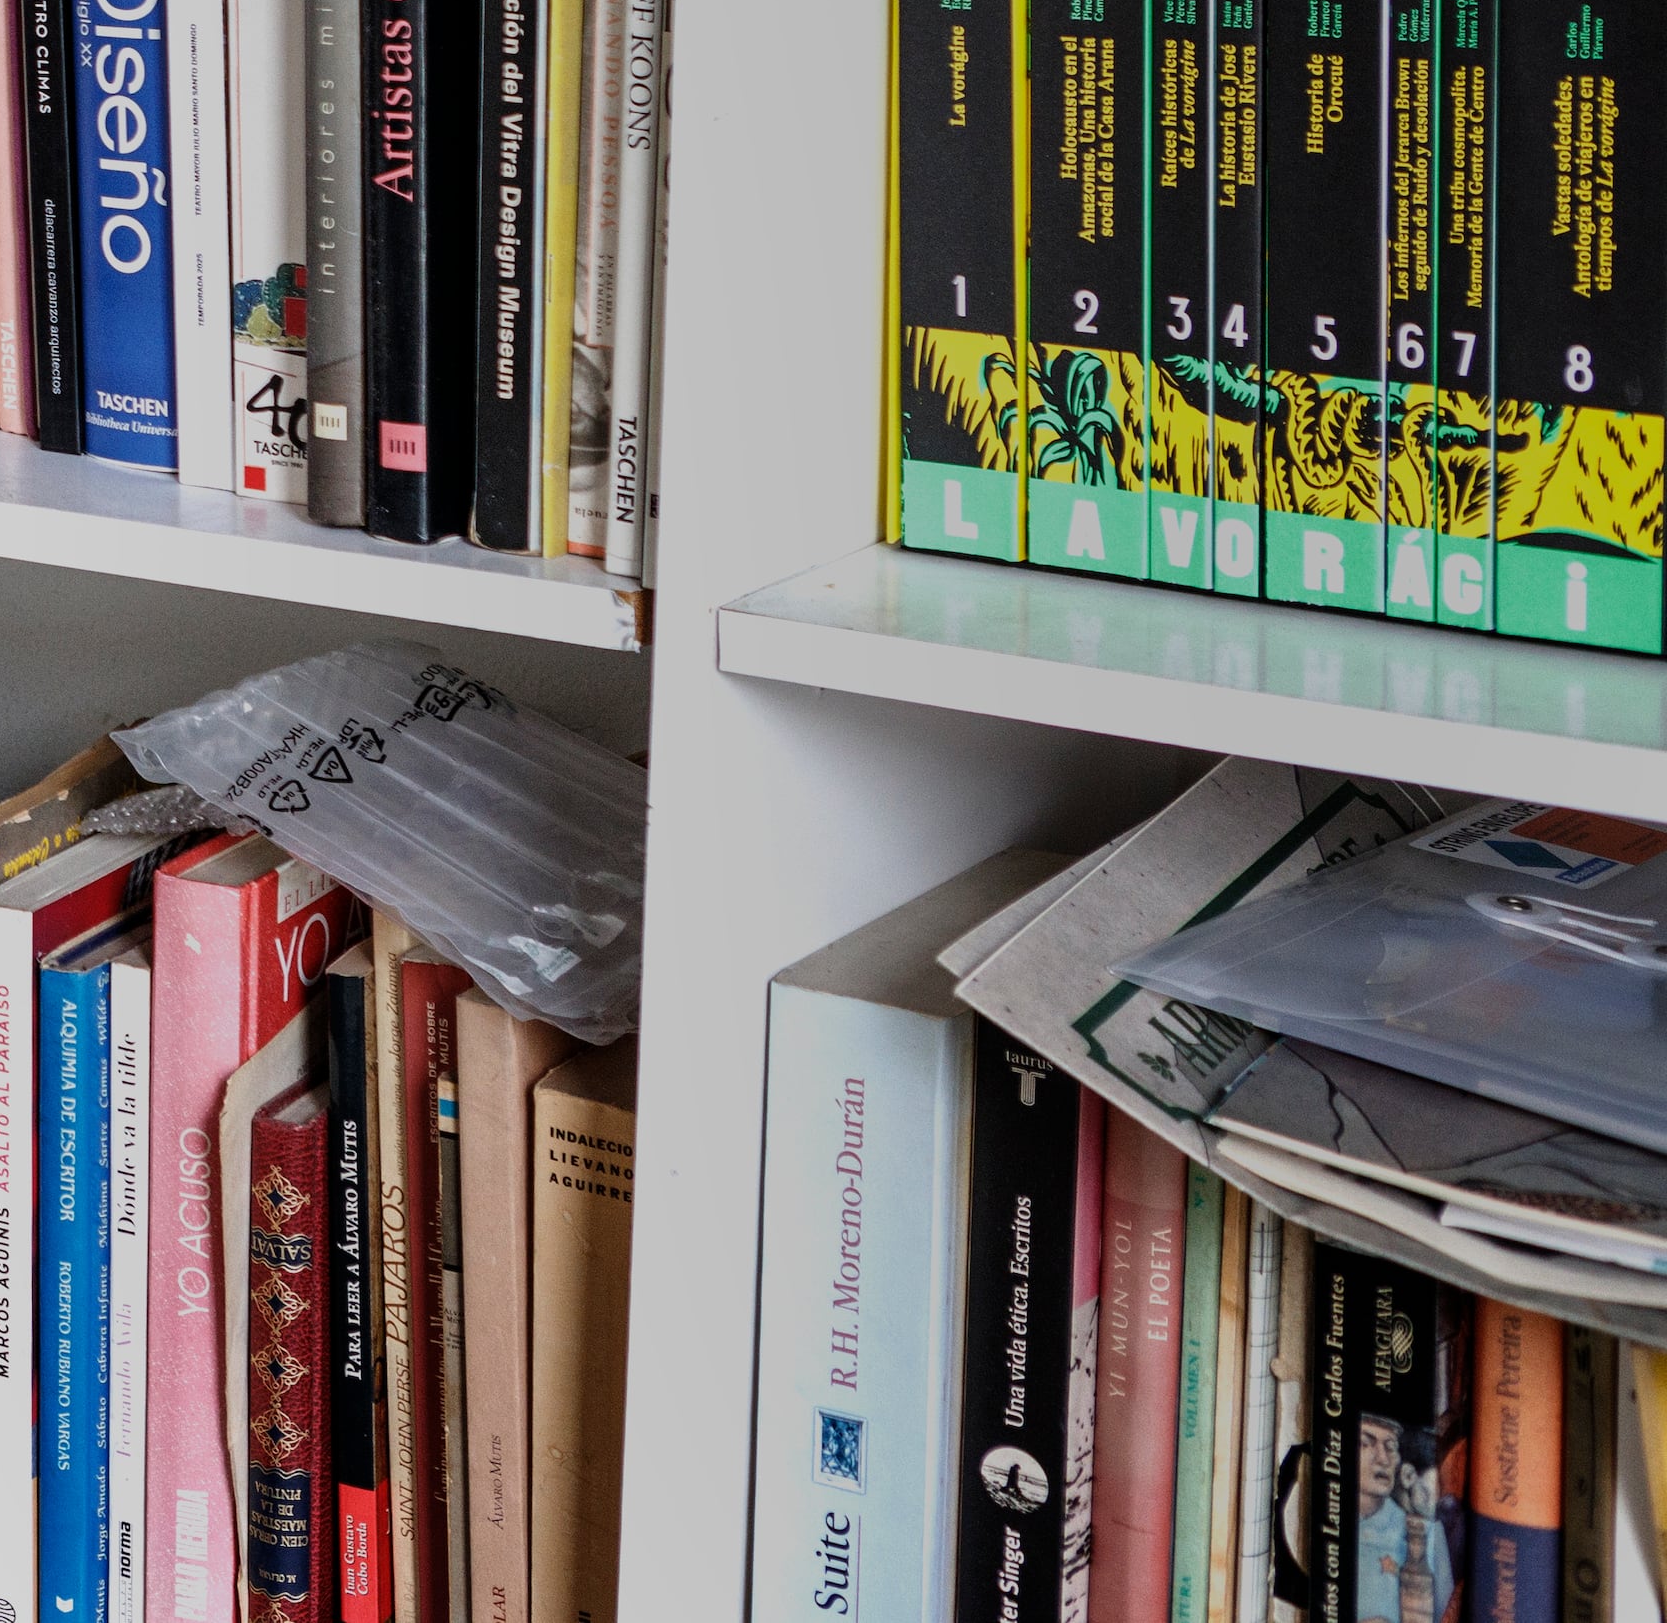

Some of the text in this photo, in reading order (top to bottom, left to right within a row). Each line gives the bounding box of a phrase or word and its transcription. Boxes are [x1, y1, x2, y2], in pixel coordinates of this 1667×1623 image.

[36, 45, 52, 115] CLIMAS
[372, 16, 415, 203] Artistas
[499, 64, 524, 106] del
[628, 33, 654, 152] KOONS
[949, 26, 969, 127] La vorágine
[499, 113, 525, 180] Vitra
[496, 188, 521, 283] Design
[952, 275, 966, 318] 1
[1074, 291, 1098, 334] 2
[1168, 298, 1192, 339] 3
[1223, 306, 1248, 347] 4
[495, 289, 521, 400] Museum
[1313, 318, 1337, 360] 5
[1397, 324, 1424, 368] 6
[1451, 332, 1476, 376] 7
[1567, 347, 1592, 392] 8
[615, 415, 638, 524] TASCHEN
[549, 1126, 634, 1157] INDALECIO
[549, 1172, 633, 1204] AGUIRRE
[177, 1127, 214, 1319] YO ACUSO
[832, 1076, 865, 1392] R.H. Moreno-Durán
[1004, 1195, 1032, 1429] Una vida ética. Escritos
[1324, 1274, 1345, 1417] Carlos Fuentes
[813, 1512, 851, 1615] Suite
